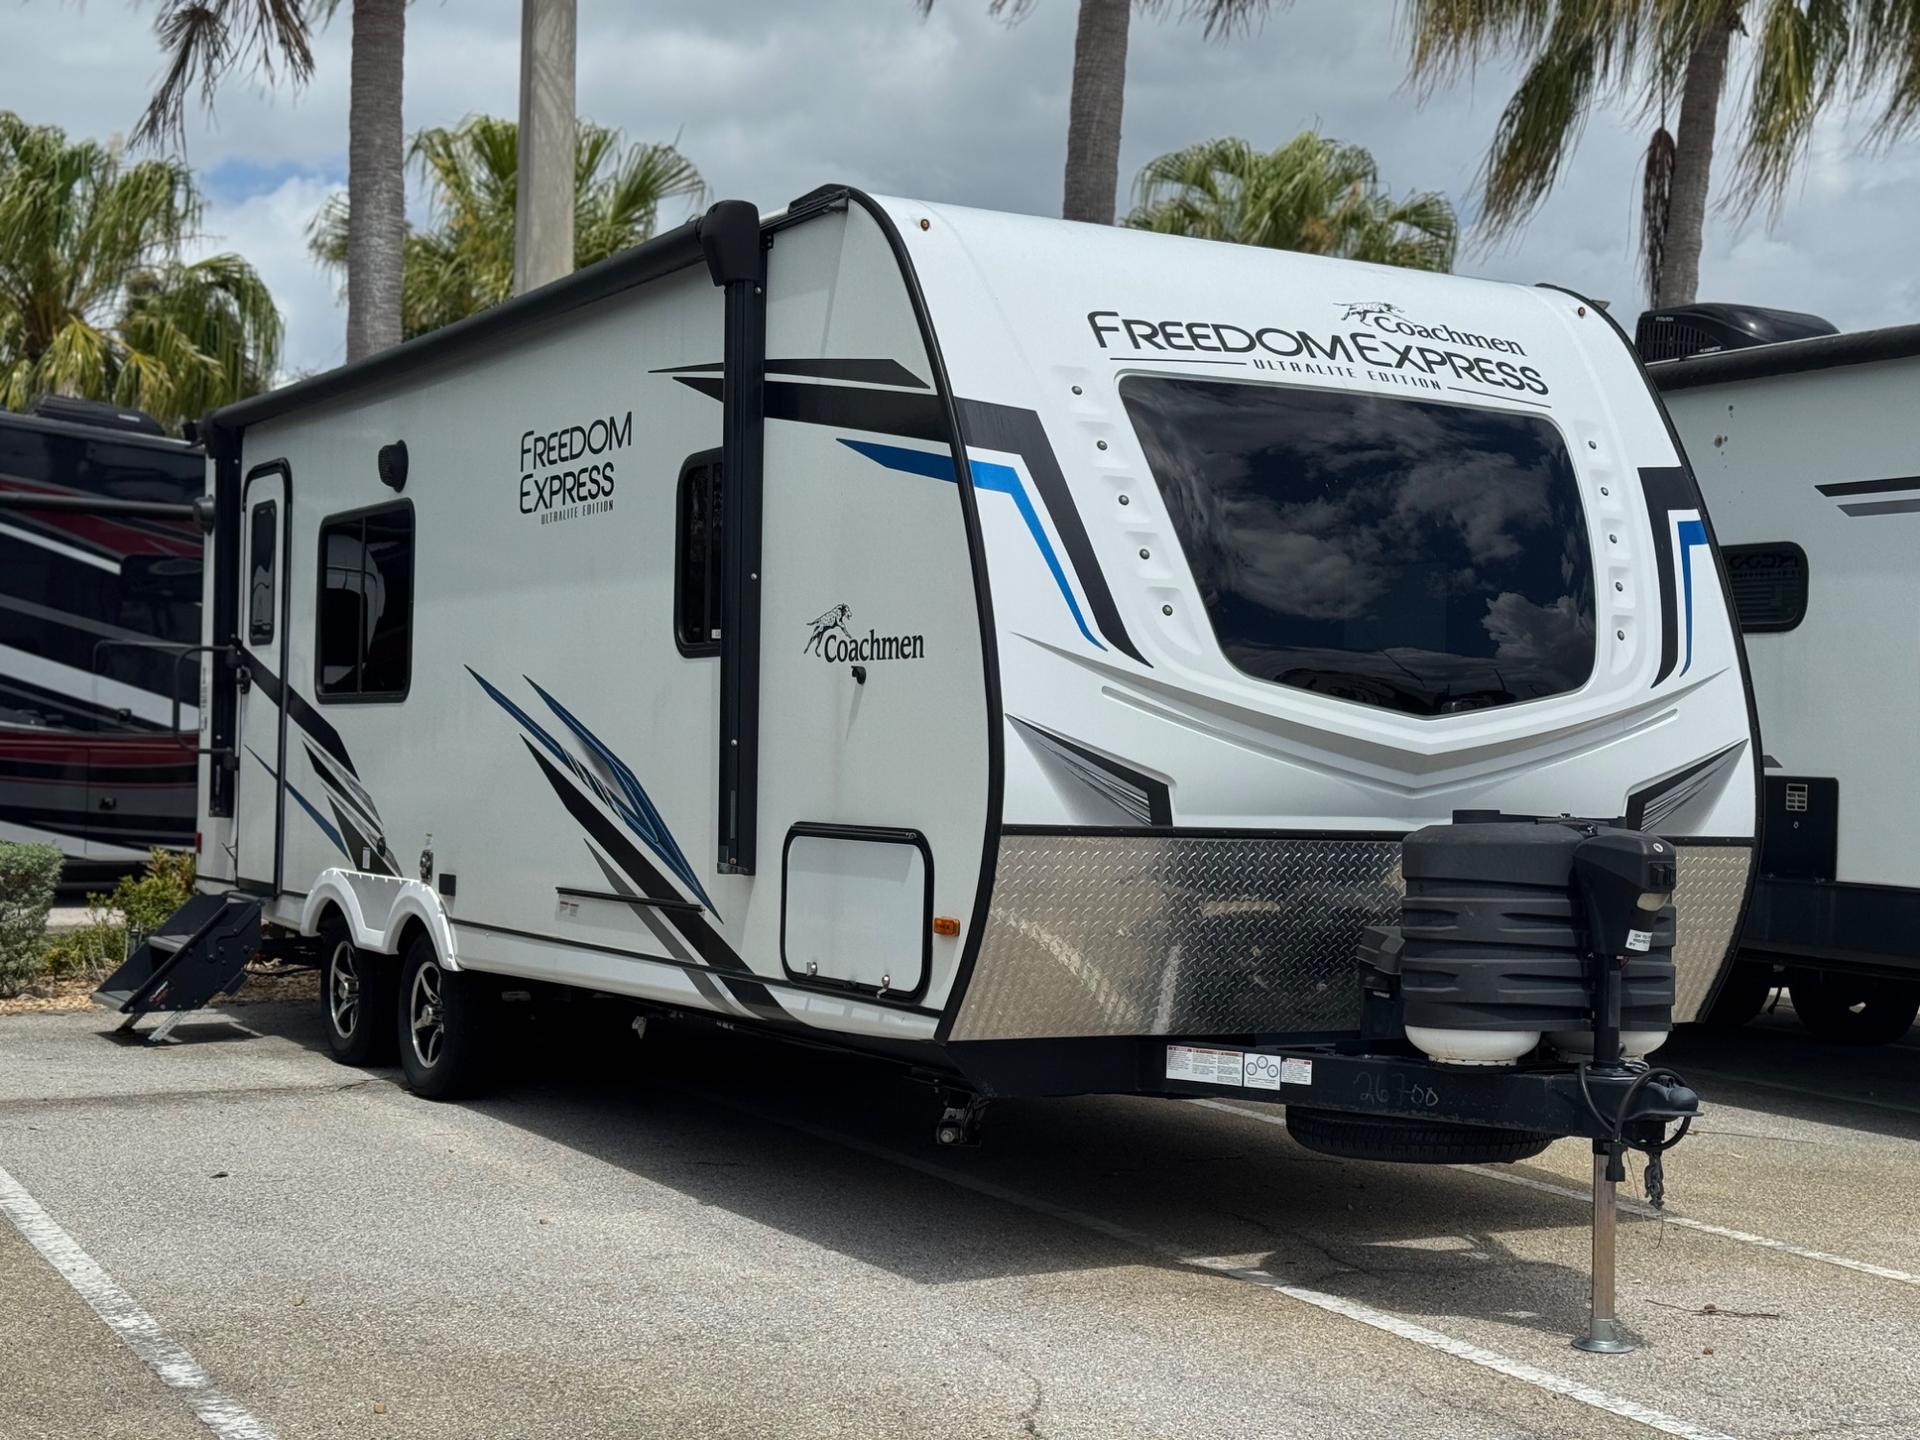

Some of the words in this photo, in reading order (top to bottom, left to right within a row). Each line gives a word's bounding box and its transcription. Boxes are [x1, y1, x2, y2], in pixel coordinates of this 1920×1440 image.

[1374, 316, 1528, 357] Coachmen
[1253, 359, 1358, 378] ULTRALITE
[1368, 371, 1442, 390] EDITION
[520, 411, 632, 472] FREEDOM
[520, 462, 614, 514] EXPRESS
[541, 506, 578, 525] ULTRALITE
[582, 500, 613, 516] EDITION
[824, 629, 925, 663] Coachmen
